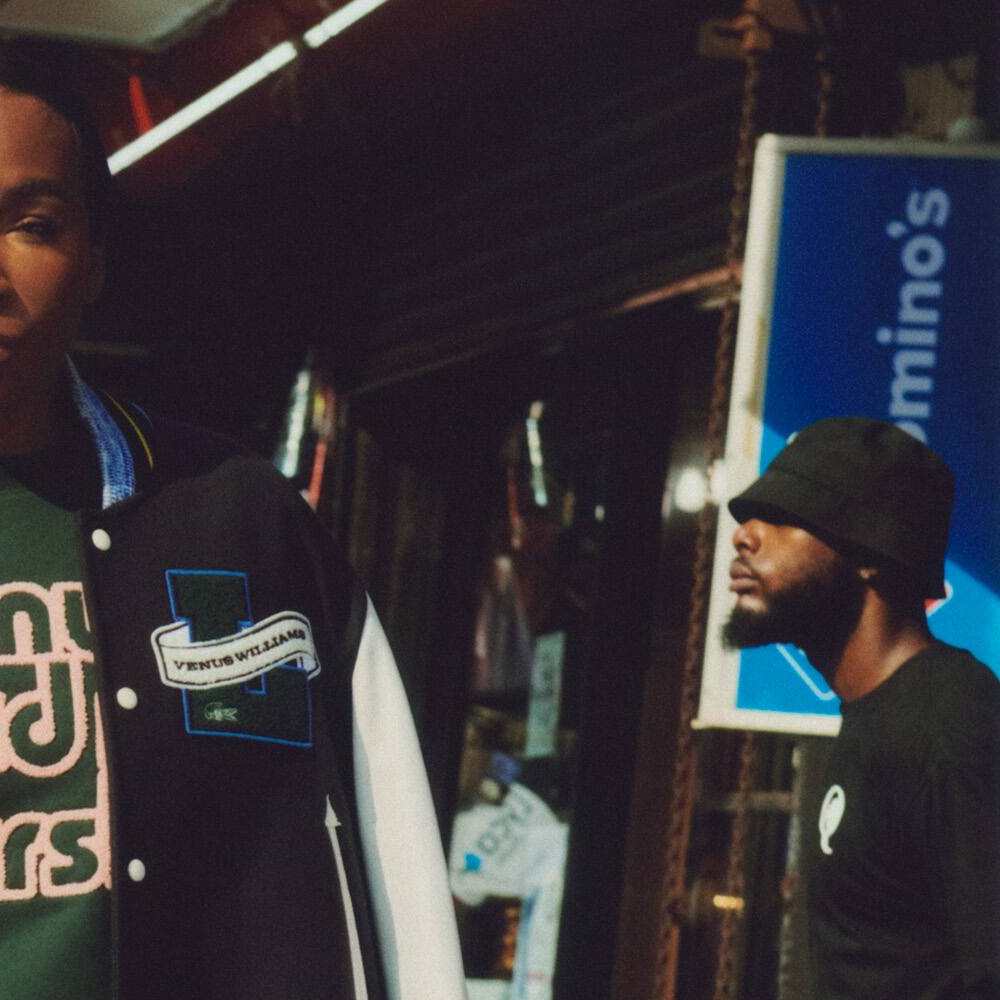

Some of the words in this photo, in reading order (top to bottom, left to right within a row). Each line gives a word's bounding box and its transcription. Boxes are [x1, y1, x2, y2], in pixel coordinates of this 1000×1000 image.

[876, 187, 951, 443] mino's
[173, 654, 235, 672] VENUS
[235, 628, 306, 663] WILLIAMS
